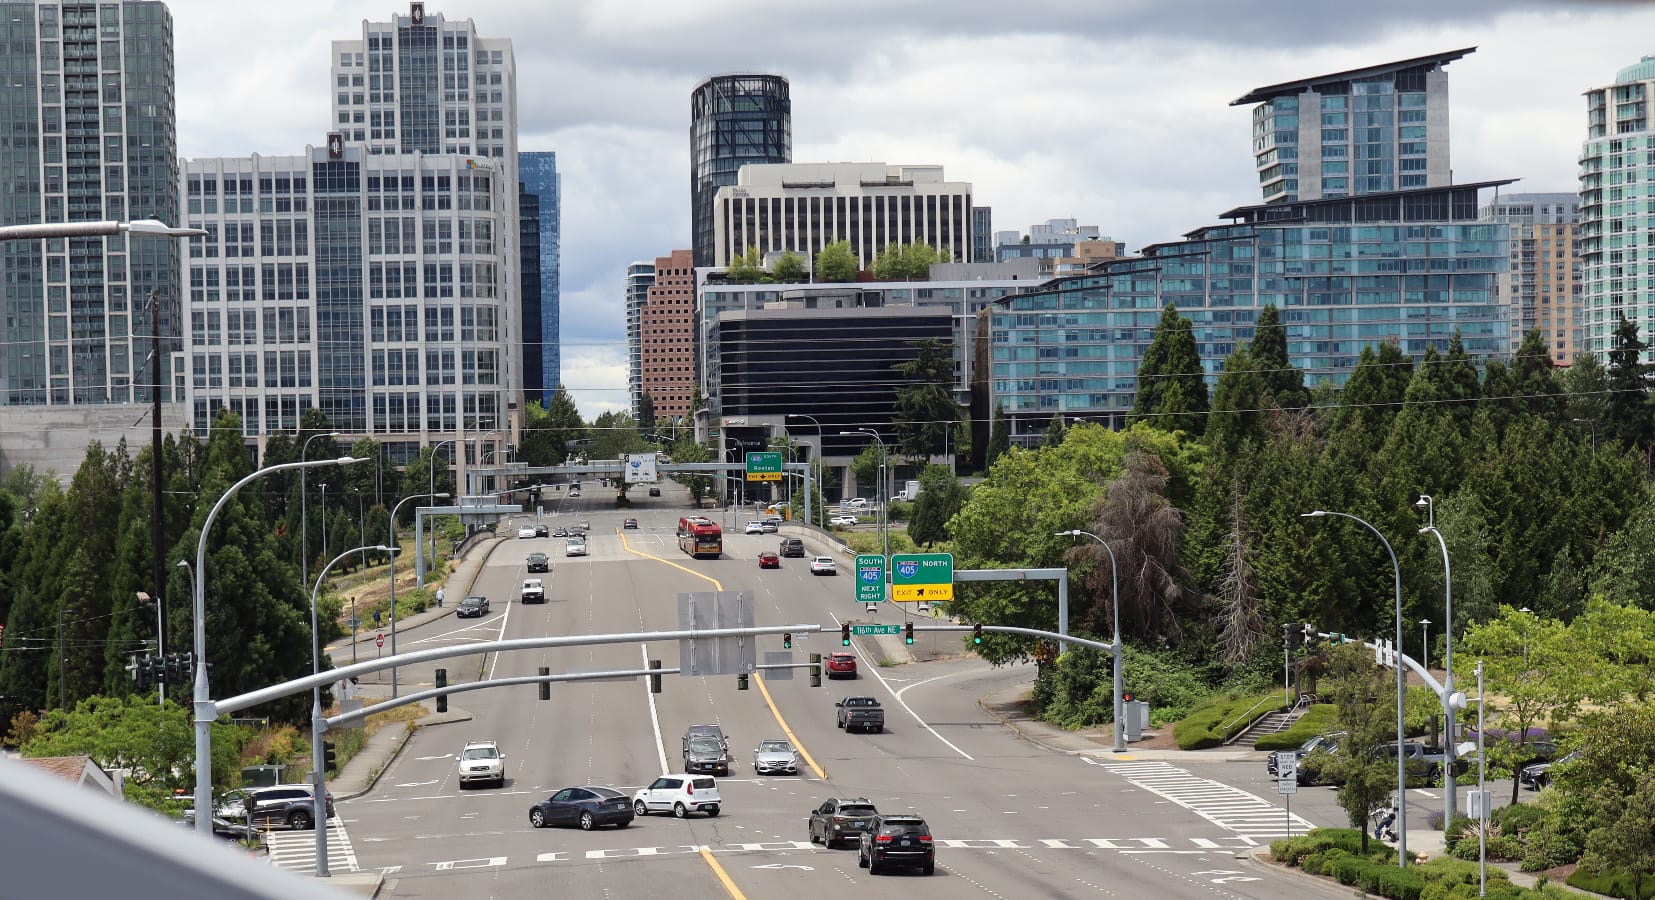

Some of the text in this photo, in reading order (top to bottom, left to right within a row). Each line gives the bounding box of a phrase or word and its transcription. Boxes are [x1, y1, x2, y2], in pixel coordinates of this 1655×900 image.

[900, 565, 915, 574] 405
[863, 571, 878, 580] 405
[857, 626, 897, 635] 116th Ave NE
